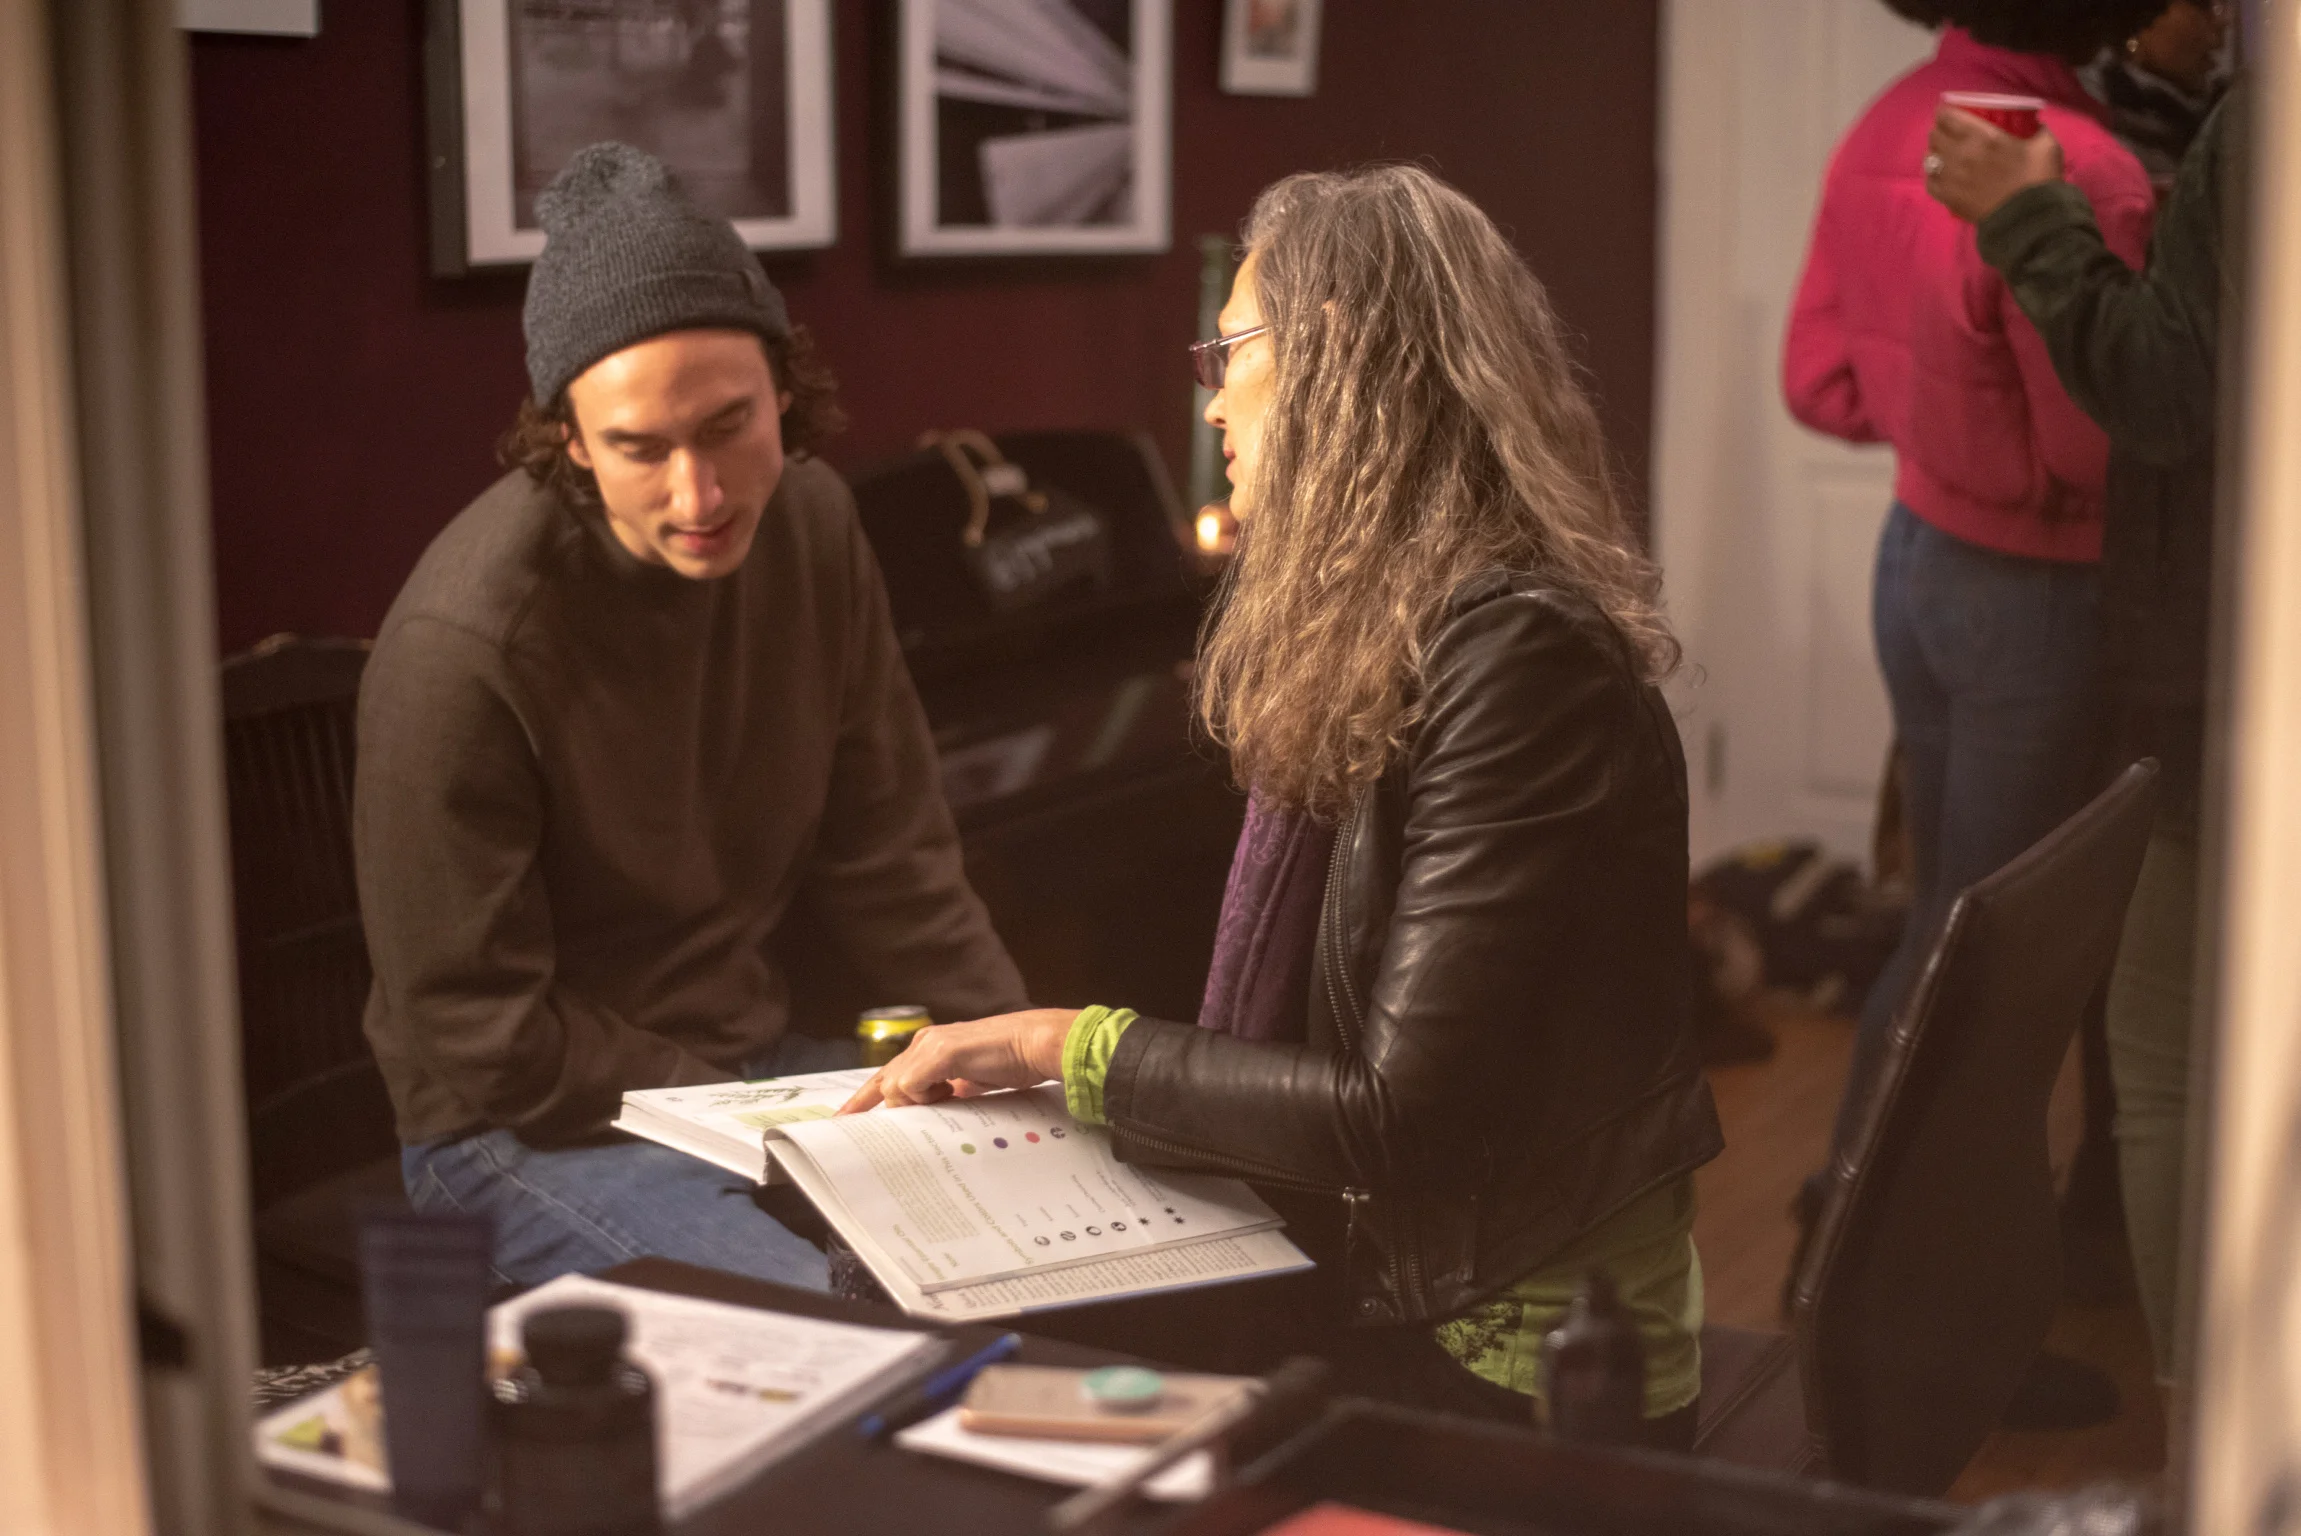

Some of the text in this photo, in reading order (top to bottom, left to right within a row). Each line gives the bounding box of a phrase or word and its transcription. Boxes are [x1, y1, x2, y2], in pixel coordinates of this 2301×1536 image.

[921, 1130, 943, 1155] Section
[942, 1156, 955, 1174] This
[958, 1181, 977, 1202] Used
[974, 1201, 996, 1225] Colors
[992, 1224, 1009, 1239] and
[1007, 1238, 1034, 1265] Symbols
